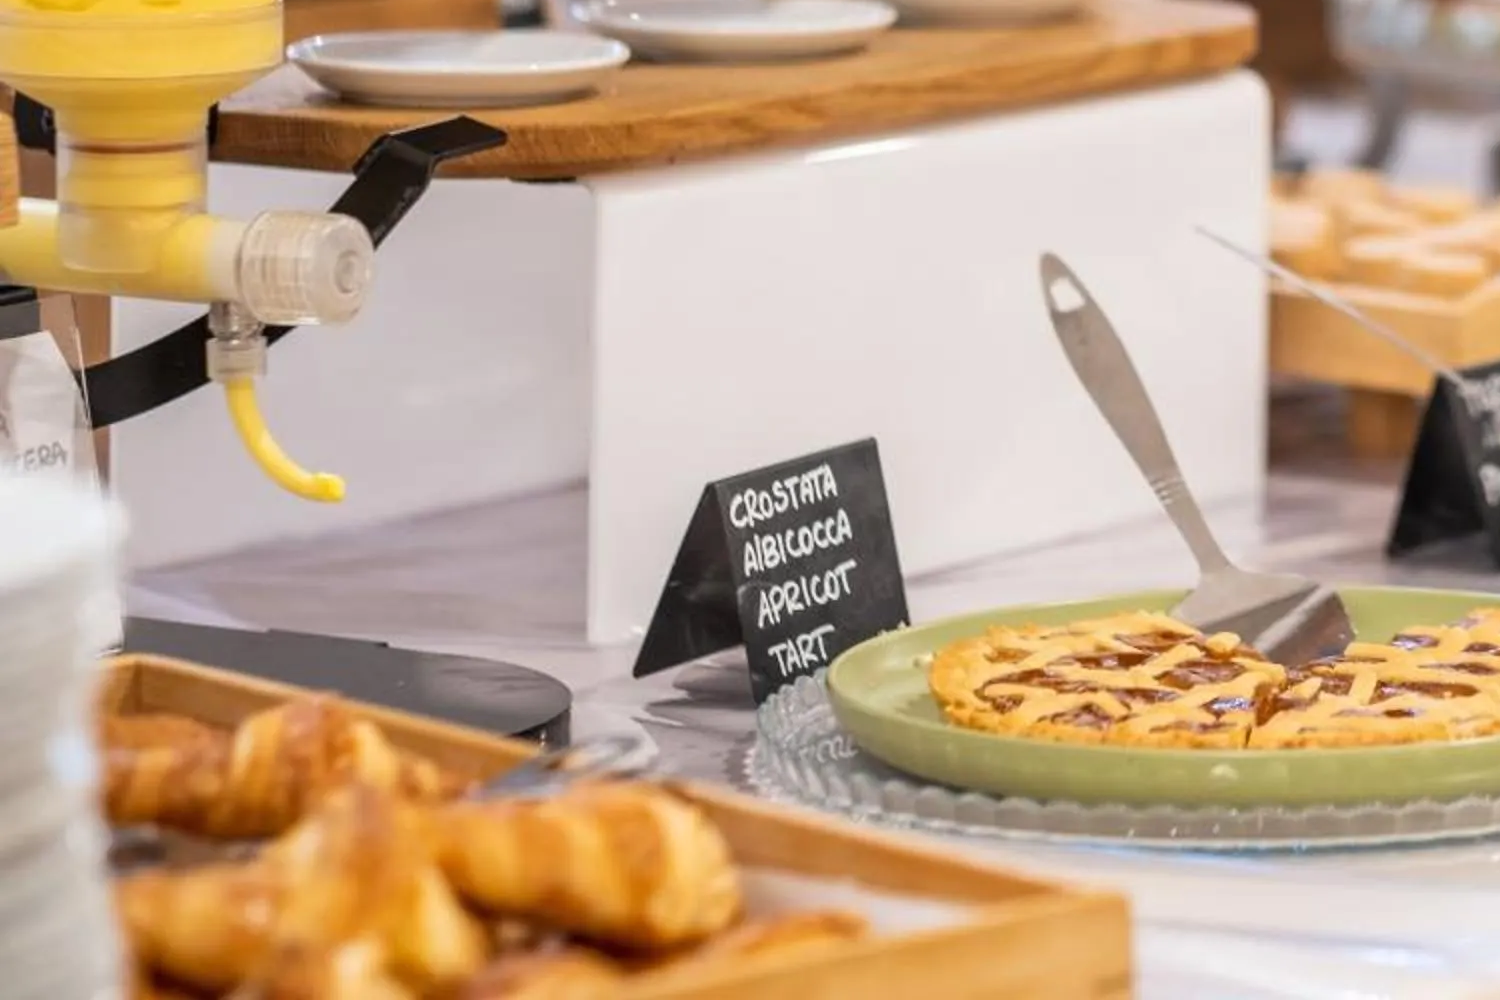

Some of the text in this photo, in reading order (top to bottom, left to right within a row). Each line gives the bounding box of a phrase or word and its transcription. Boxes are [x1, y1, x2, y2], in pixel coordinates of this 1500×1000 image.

[729, 463, 838, 529] CROSTATA
[757, 558, 857, 629] APRICOT
[767, 623, 835, 677] TART
